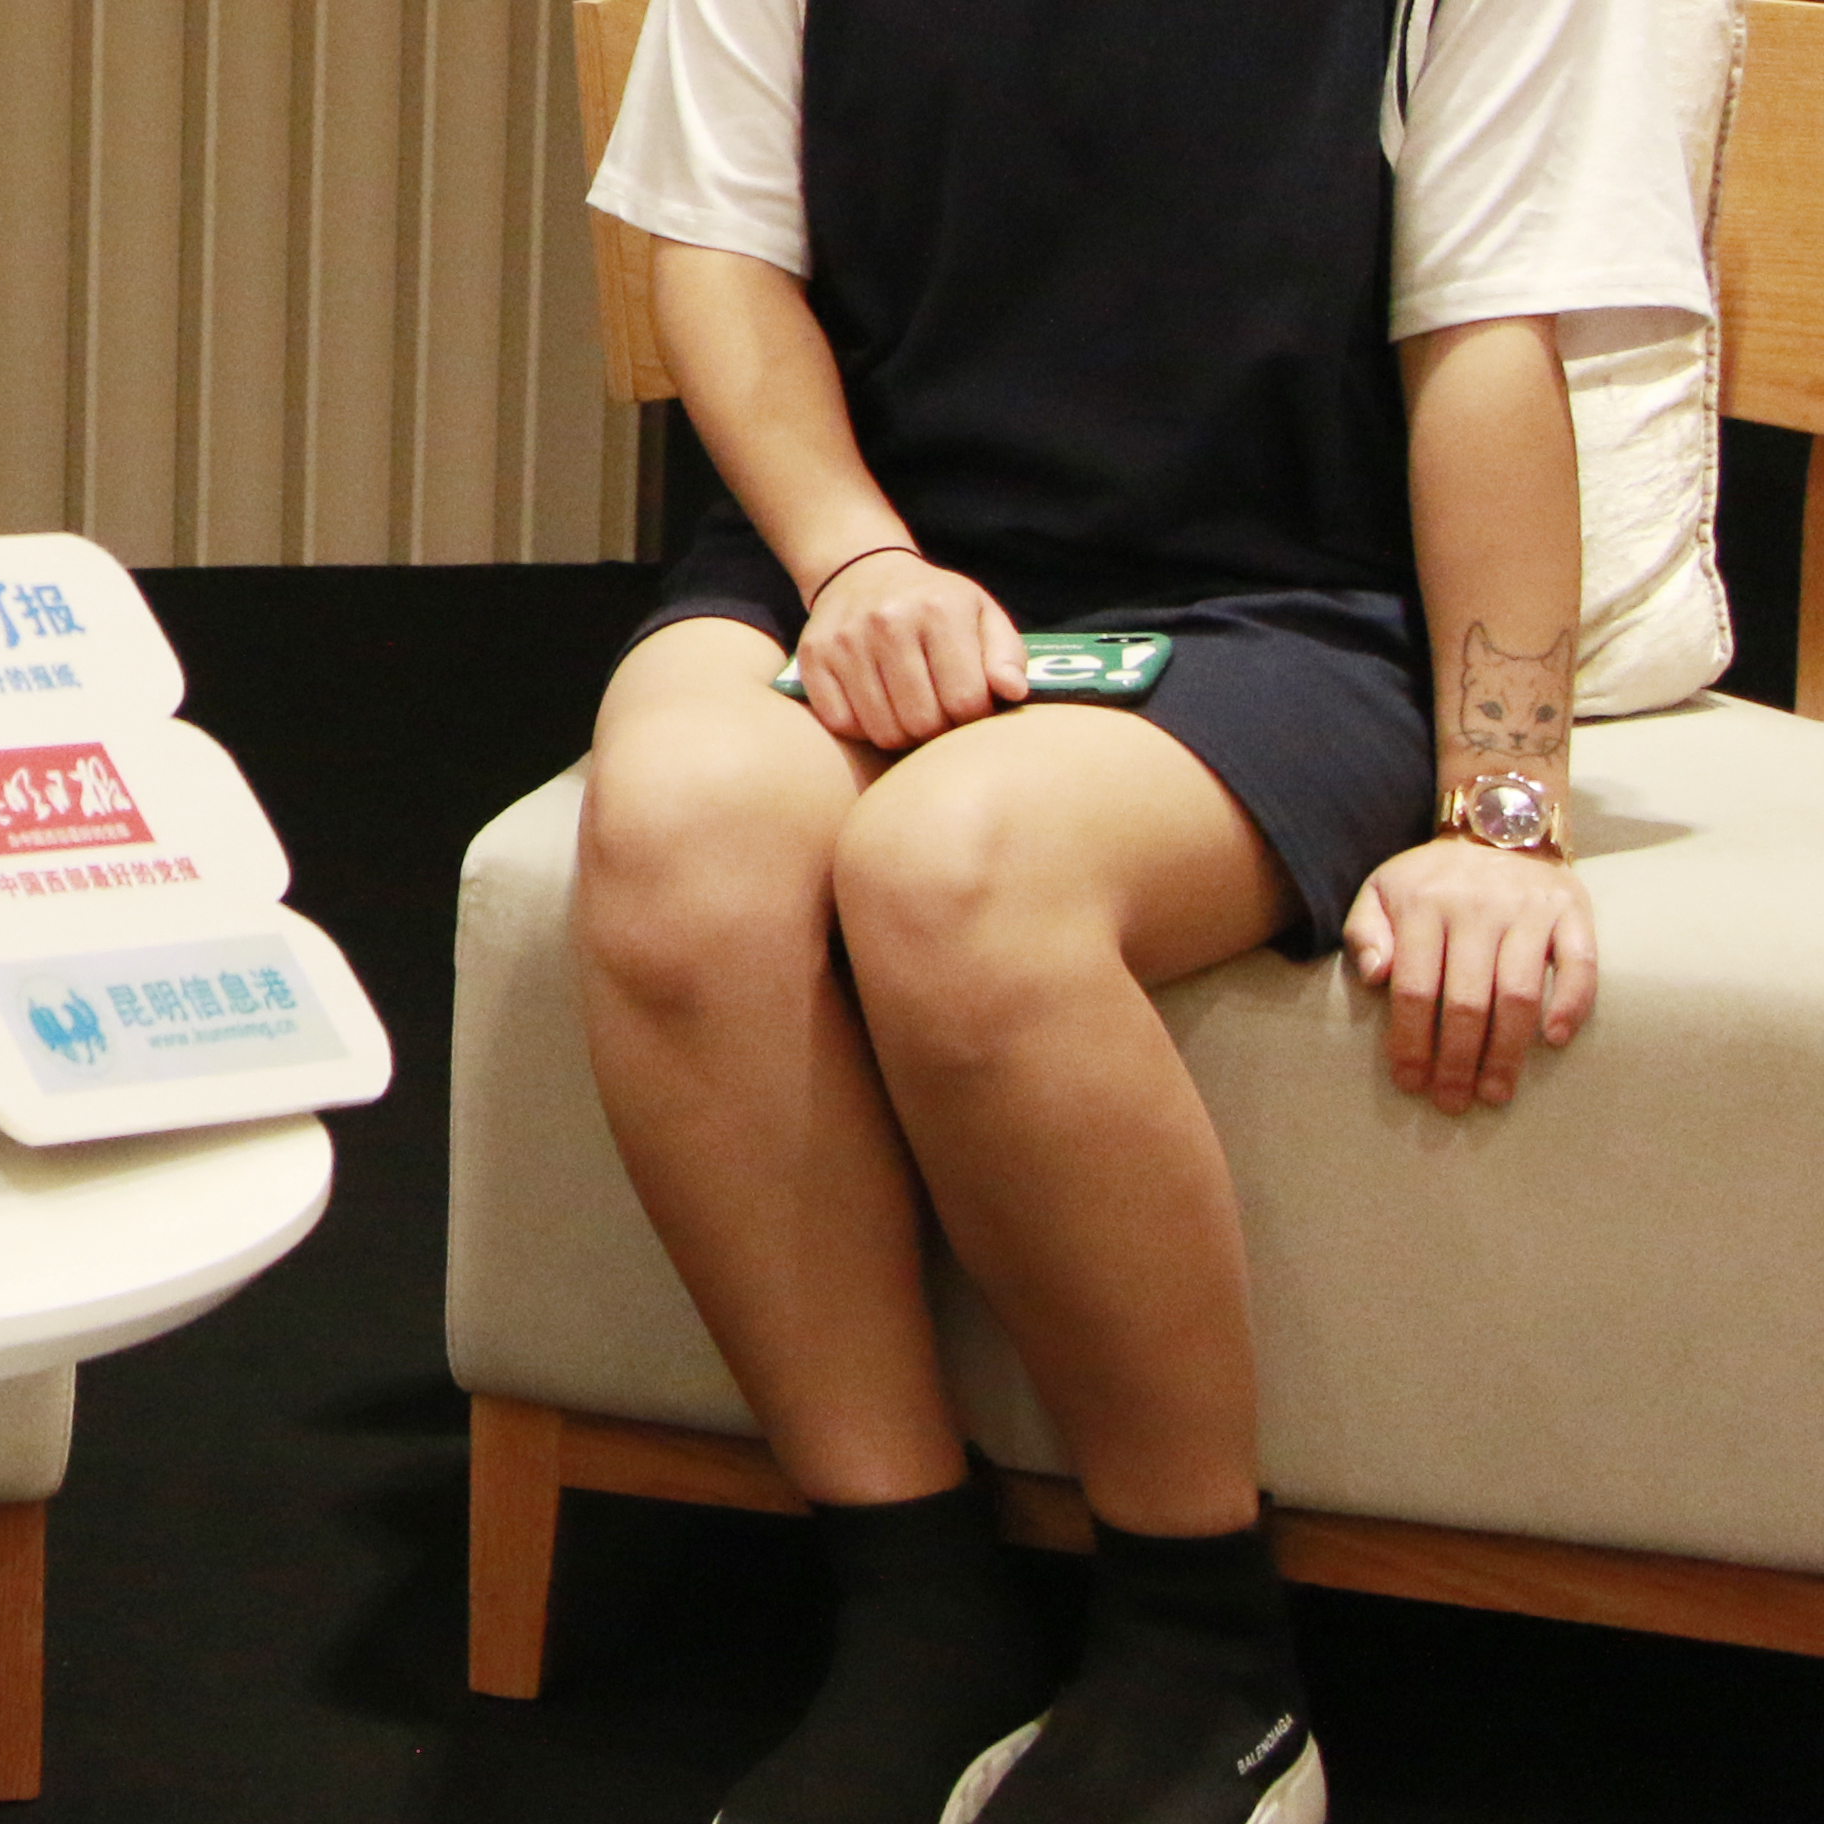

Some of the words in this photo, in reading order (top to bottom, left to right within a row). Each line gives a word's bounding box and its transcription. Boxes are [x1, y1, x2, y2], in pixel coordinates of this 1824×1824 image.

[107, 968, 297, 1027] 昆明信息港
